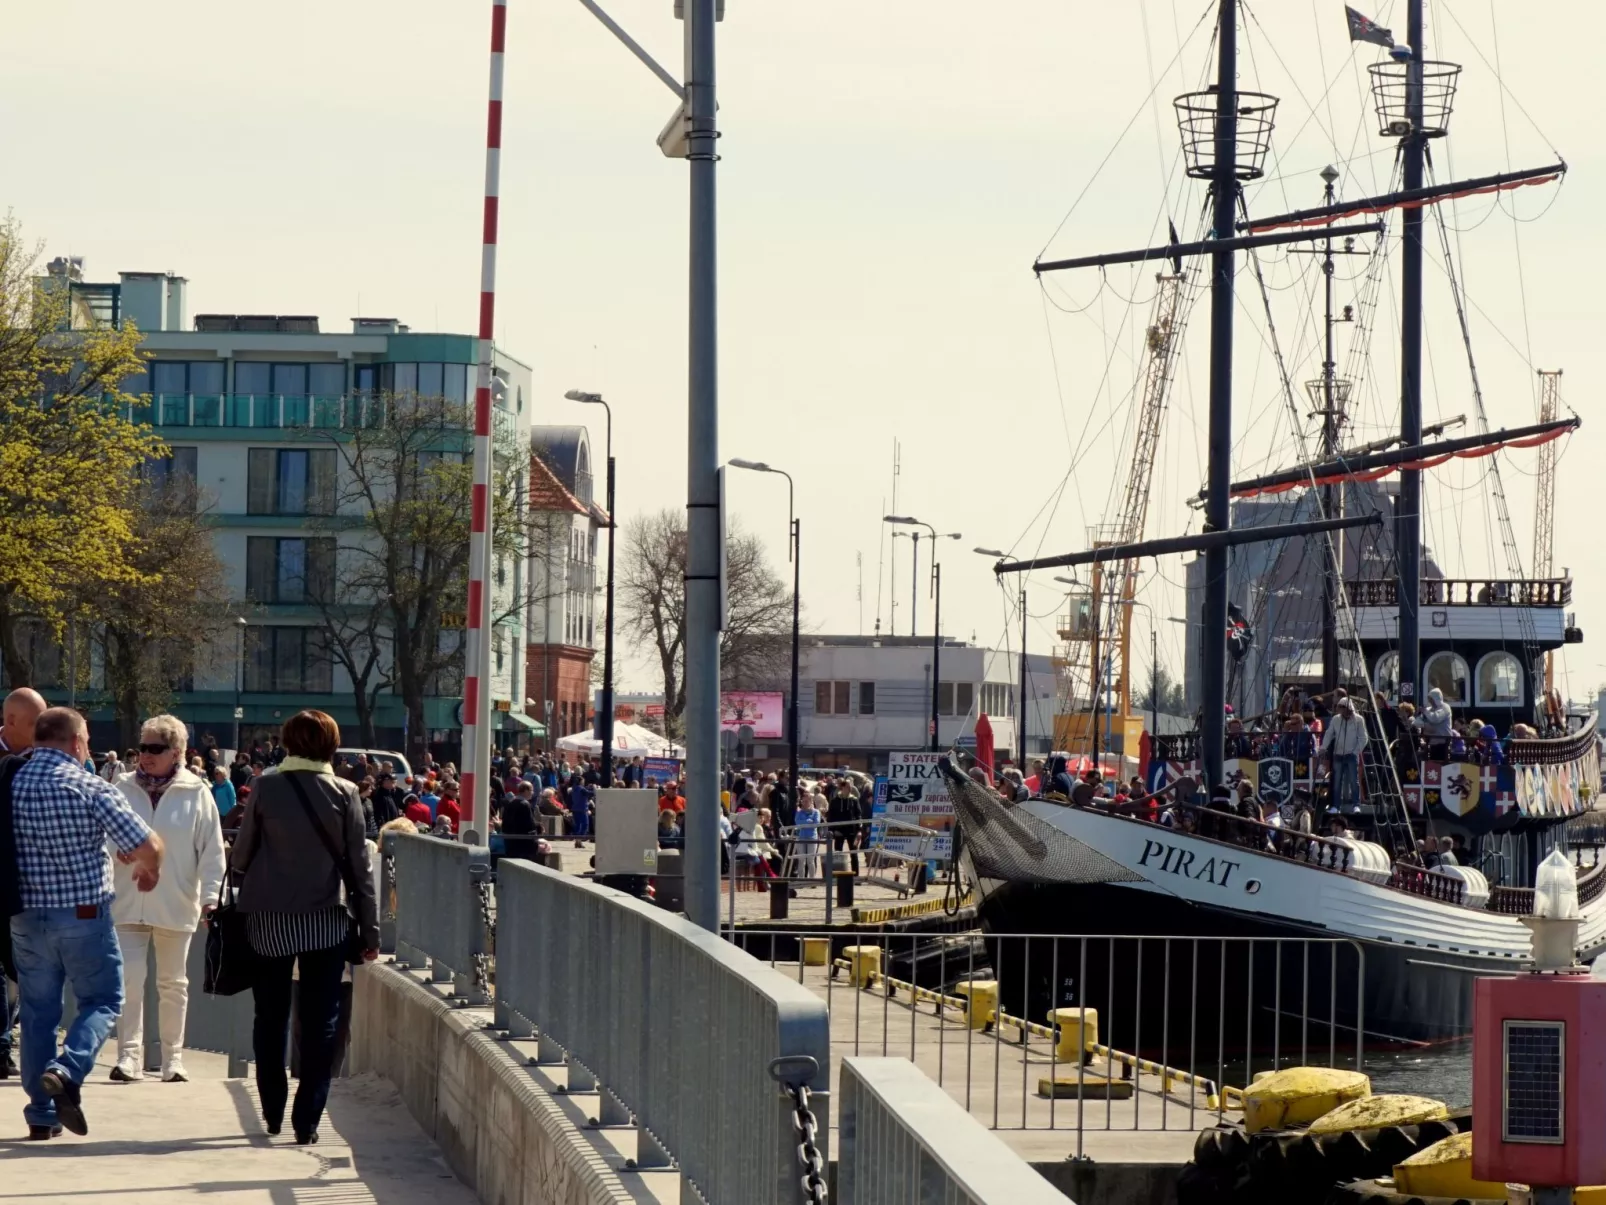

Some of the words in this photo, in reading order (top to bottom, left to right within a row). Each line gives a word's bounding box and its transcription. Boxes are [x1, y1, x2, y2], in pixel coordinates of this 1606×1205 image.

[892, 764, 942, 779] PIRA
[925, 794, 950, 803] zaprasz
[1137, 839, 1241, 888] PIRAT
